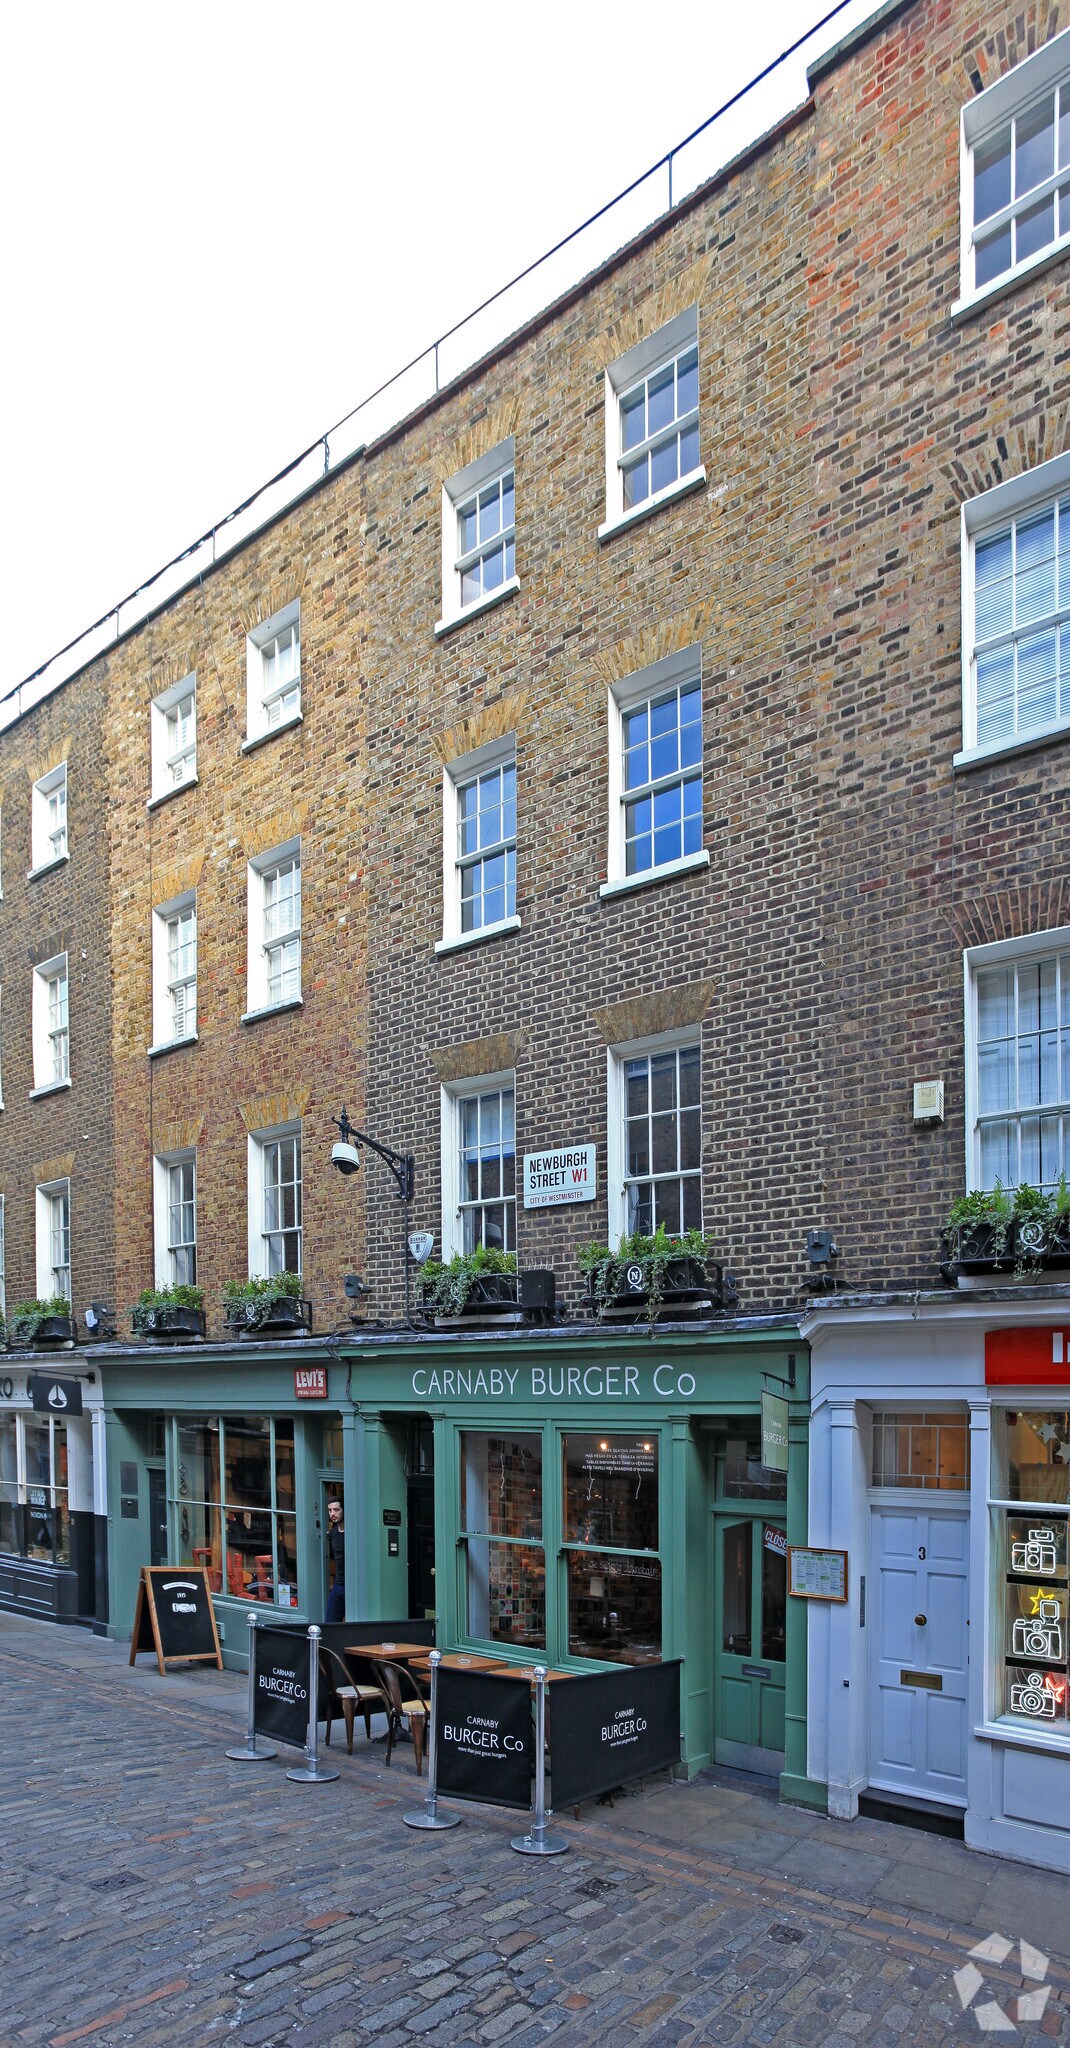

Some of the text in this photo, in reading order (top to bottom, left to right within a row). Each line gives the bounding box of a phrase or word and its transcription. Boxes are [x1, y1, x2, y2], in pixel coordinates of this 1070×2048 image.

[529, 1151, 587, 1173] NEWBURGH
[530, 1167, 587, 1189] STREET W1
[548, 1191, 584, 1202] WESTMINSTER
[1052, 1332, 1070, 1364] I
[296, 1369, 324, 1388] LEVI'S
[412, 1364, 696, 1396] CARNABY BURGER Co
[763, 1430, 783, 1445] BURGER
[765, 1530, 788, 1550] CLOSE
[918, 1546, 926, 1560] 3
[272, 1667, 296, 1678] CARNABY
[259, 1674, 294, 1695] BURGER
[294, 1684, 307, 1699] Co
[467, 1715, 499, 1729] CARNABY
[614, 1708, 635, 1719] CARNABY
[444, 1725, 524, 1752] BURGER Co
[601, 1720, 635, 1741] BURGER
[636, 1717, 647, 1731] Co
